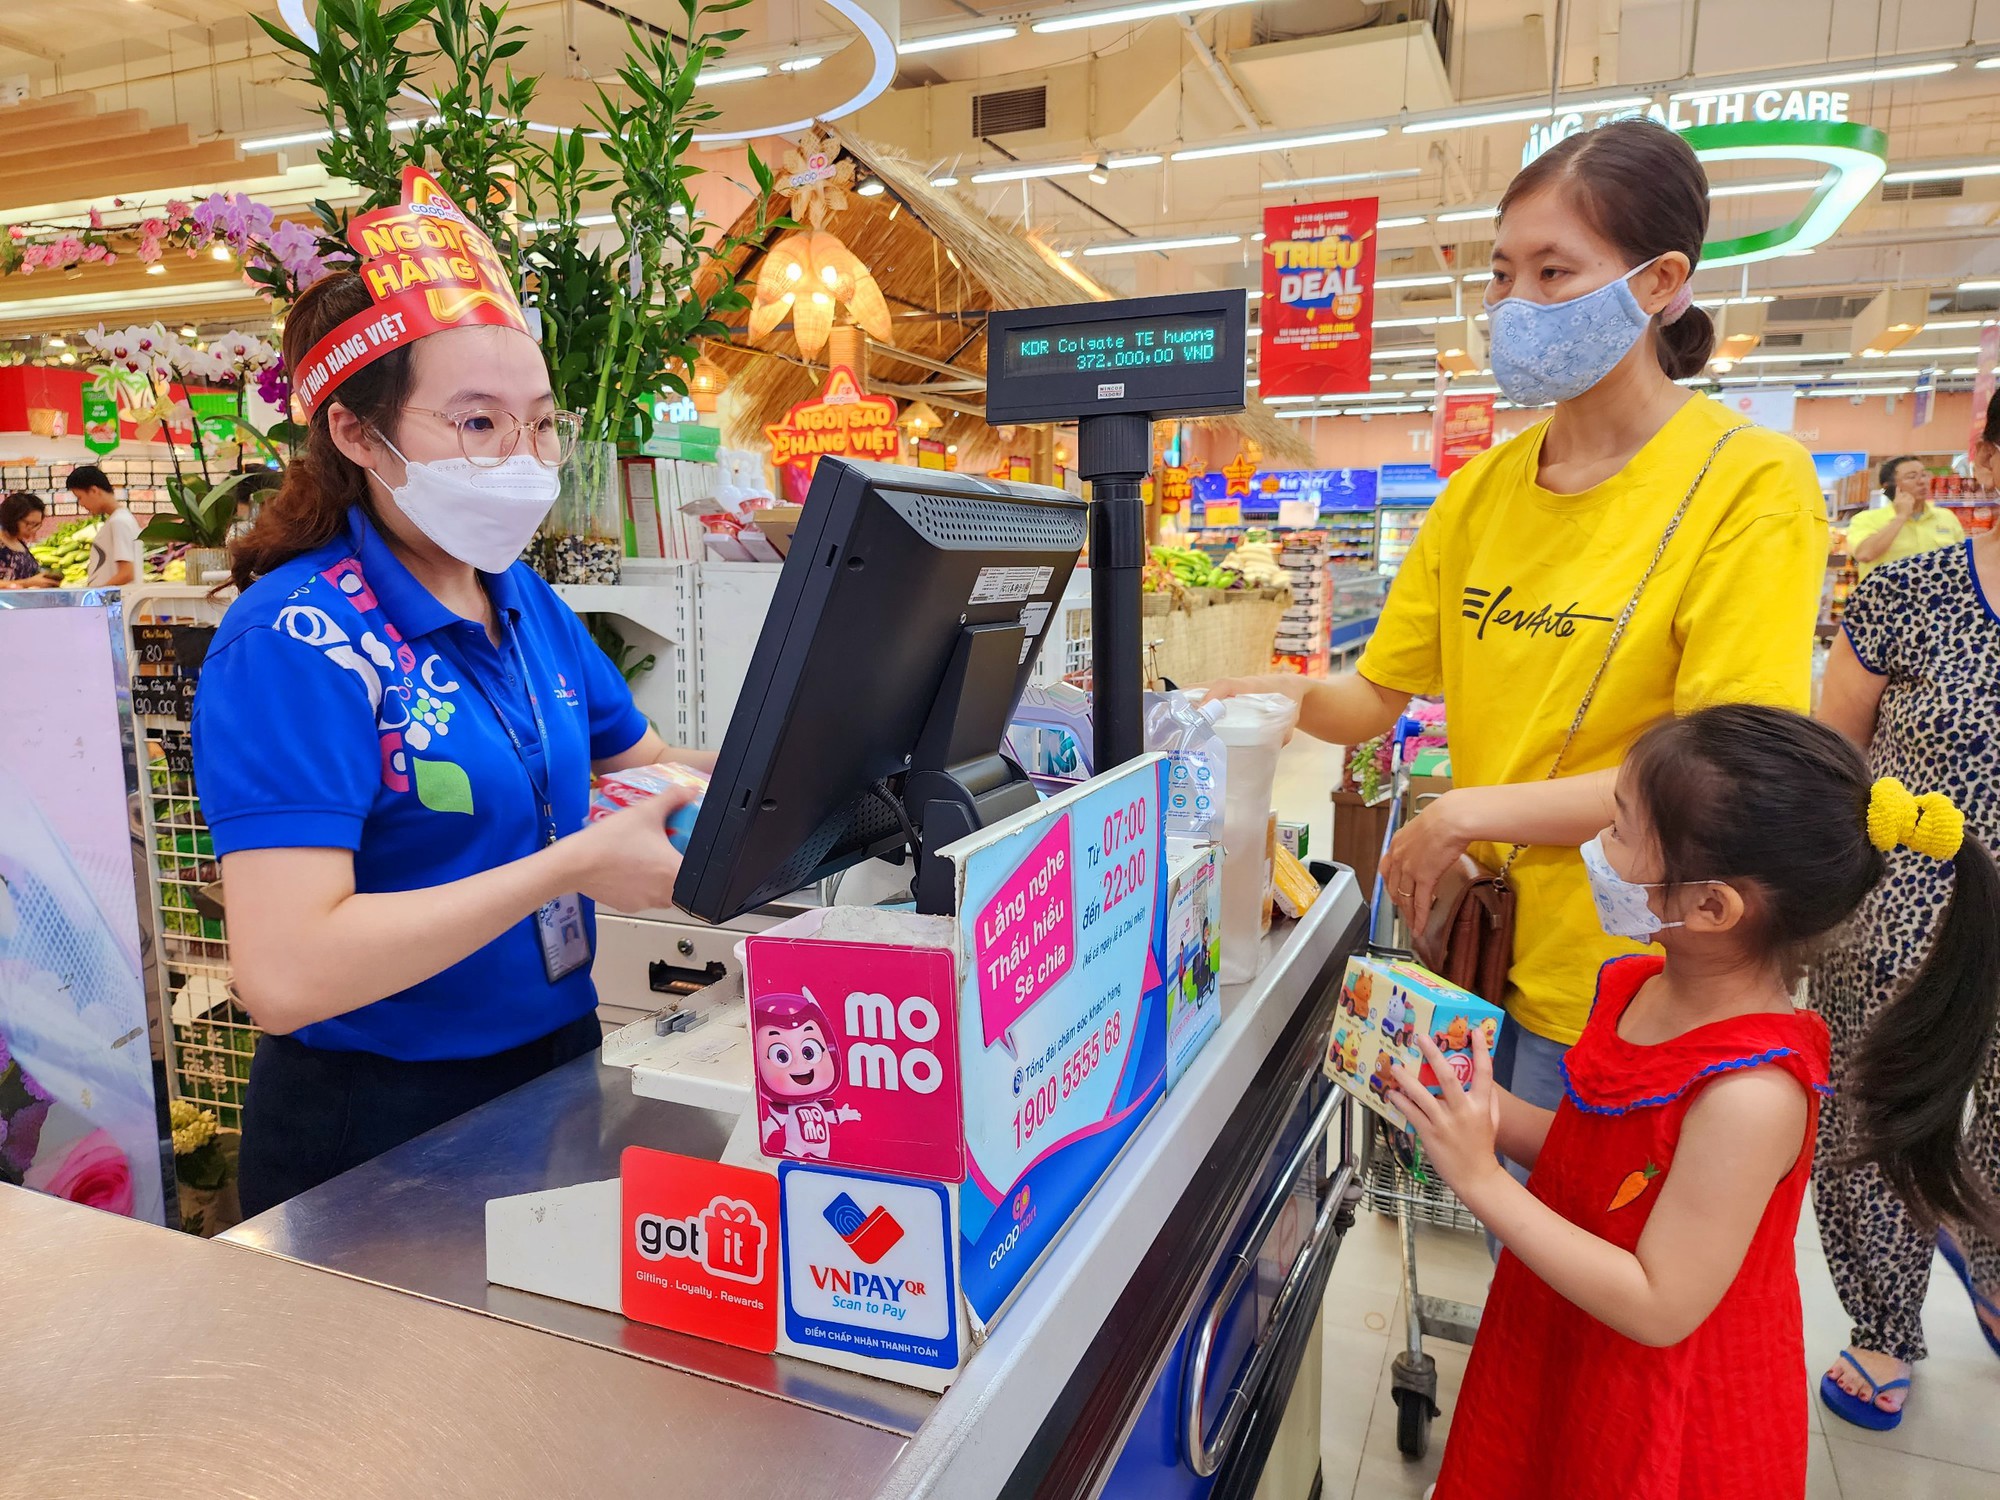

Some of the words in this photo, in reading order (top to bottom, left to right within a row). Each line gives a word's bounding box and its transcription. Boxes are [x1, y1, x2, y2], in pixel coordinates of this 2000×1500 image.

[1754, 91, 1850, 122] CARE
[361, 223, 460, 256] NGÔI
[367, 255, 475, 299] HÀNG
[1281, 269, 1363, 303] DEAL
[307, 364, 329, 396] HÀO
[325, 333, 369, 376] HÀNG
[365, 311, 408, 343] VIỆT
[1021, 340, 1049, 356] KDR
[1058, 337, 1125, 353] Colgate
[1135, 331, 1154, 347] TE
[1164, 327, 1214, 344] huong
[1077, 348, 1174, 370] 372.000,00
[1183, 345, 1214, 361] VND
[795, 408, 843, 430] NGÔI
[849, 407, 890, 428] SAO
[790, 431, 845, 456] HÀNG
[851, 427, 897, 455] VIỆT
[1087, 841, 1101, 870] Từ
[1103, 796, 1146, 857] 07:00
[984, 889, 1025, 950] Lắng
[1029, 849, 1065, 901] nghe
[1082, 895, 1100, 931] đến
[1103, 848, 1146, 914] 22:00
[987, 933, 1029, 991] Thấu
[1033, 896, 1064, 947] hiểu
[1015, 967, 1034, 1004] Sẻ
[1037, 944, 1065, 984] chia
[1025, 1055, 1044, 1081] Tổng
[1045, 1043, 1057, 1063] đài
[1057, 1027, 1076, 1052] chăm
[1076, 1013, 1088, 1033] sóc
[1089, 997, 1106, 1022] khách
[1107, 983, 1121, 1004] hàng
[1013, 1075, 1057, 1150] 1900
[1062, 1031, 1100, 1099] 5555
[1104, 1011, 1121, 1053] 68
[640, 1218, 699, 1255] got
[722, 1228, 743, 1266] it
[636, 1270, 668, 1289] Gifting
[675, 1281, 713, 1301] Loyalty
[720, 1290, 764, 1310] Rewards
[832, 1295, 863, 1311] Scan
[866, 1300, 879, 1312] to
[883, 1303, 906, 1320] Pay
[805, 1326, 827, 1339] ĐIỂM
[828, 1328, 852, 1343] CHẤP
[854, 1335, 880, 1350] NHẬN
[880, 1339, 911, 1353] THANH
[913, 1341, 939, 1358] TOÁN
